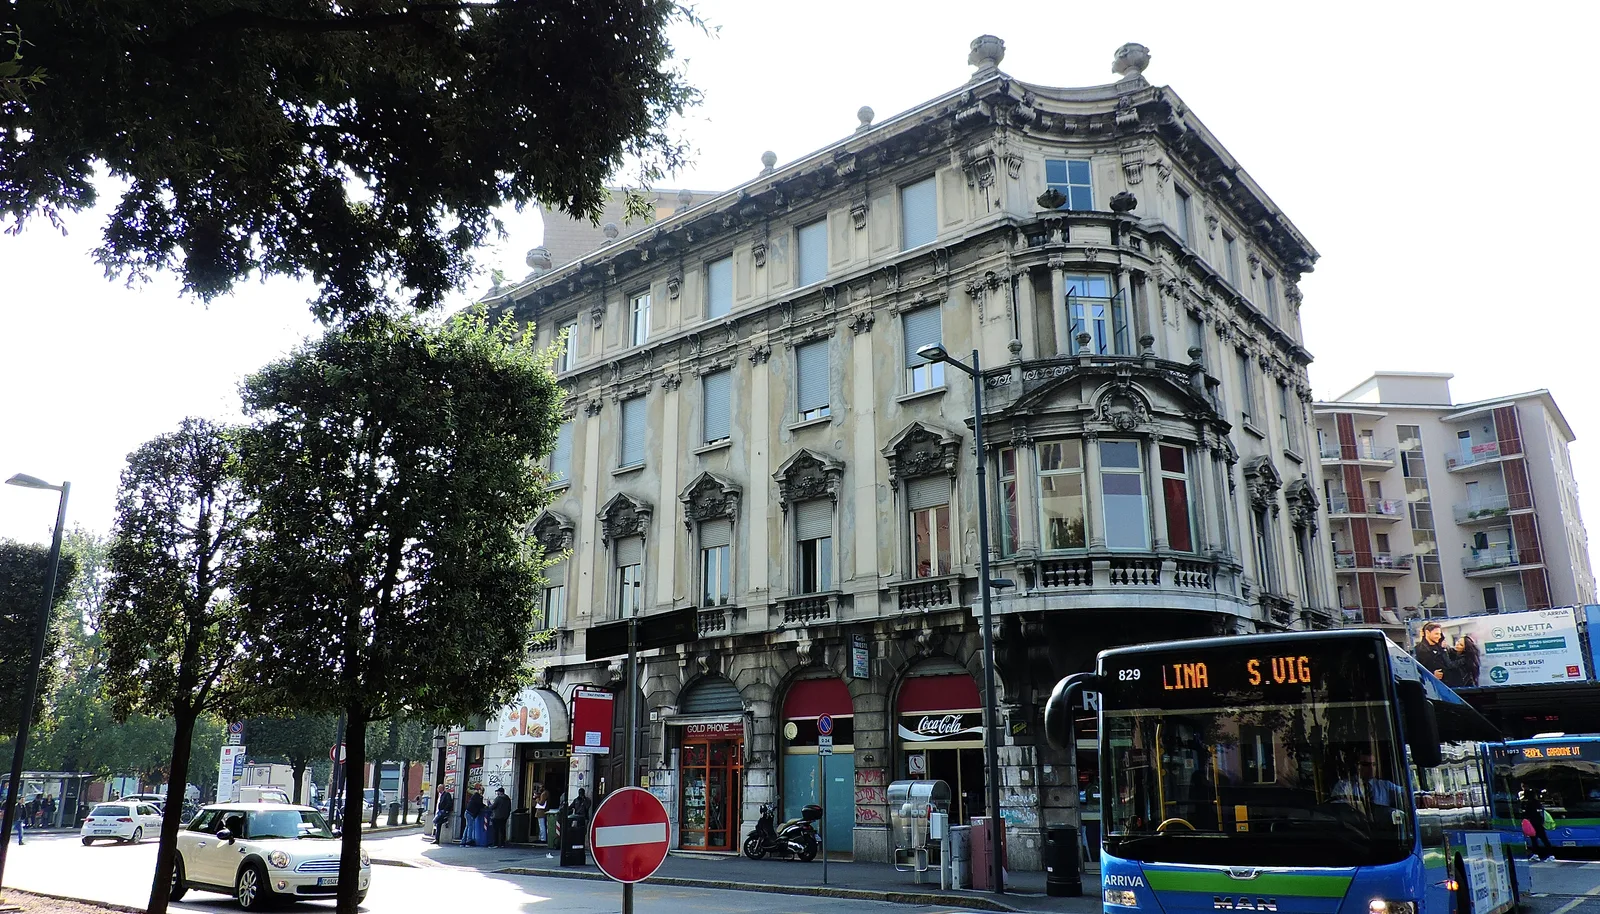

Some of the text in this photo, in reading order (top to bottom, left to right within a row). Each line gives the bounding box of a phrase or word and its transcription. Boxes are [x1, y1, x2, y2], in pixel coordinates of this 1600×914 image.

[1507, 623, 1553, 633] NAVETTA
[1118, 668, 1141, 681] 829
[1162, 662, 1208, 690] LINA
[687, 724, 705, 733] GOLD
[706, 724, 729, 732] PHONE
[1104, 874, 1144, 888] ARRIVA
[1214, 896, 1278, 912] MAN
